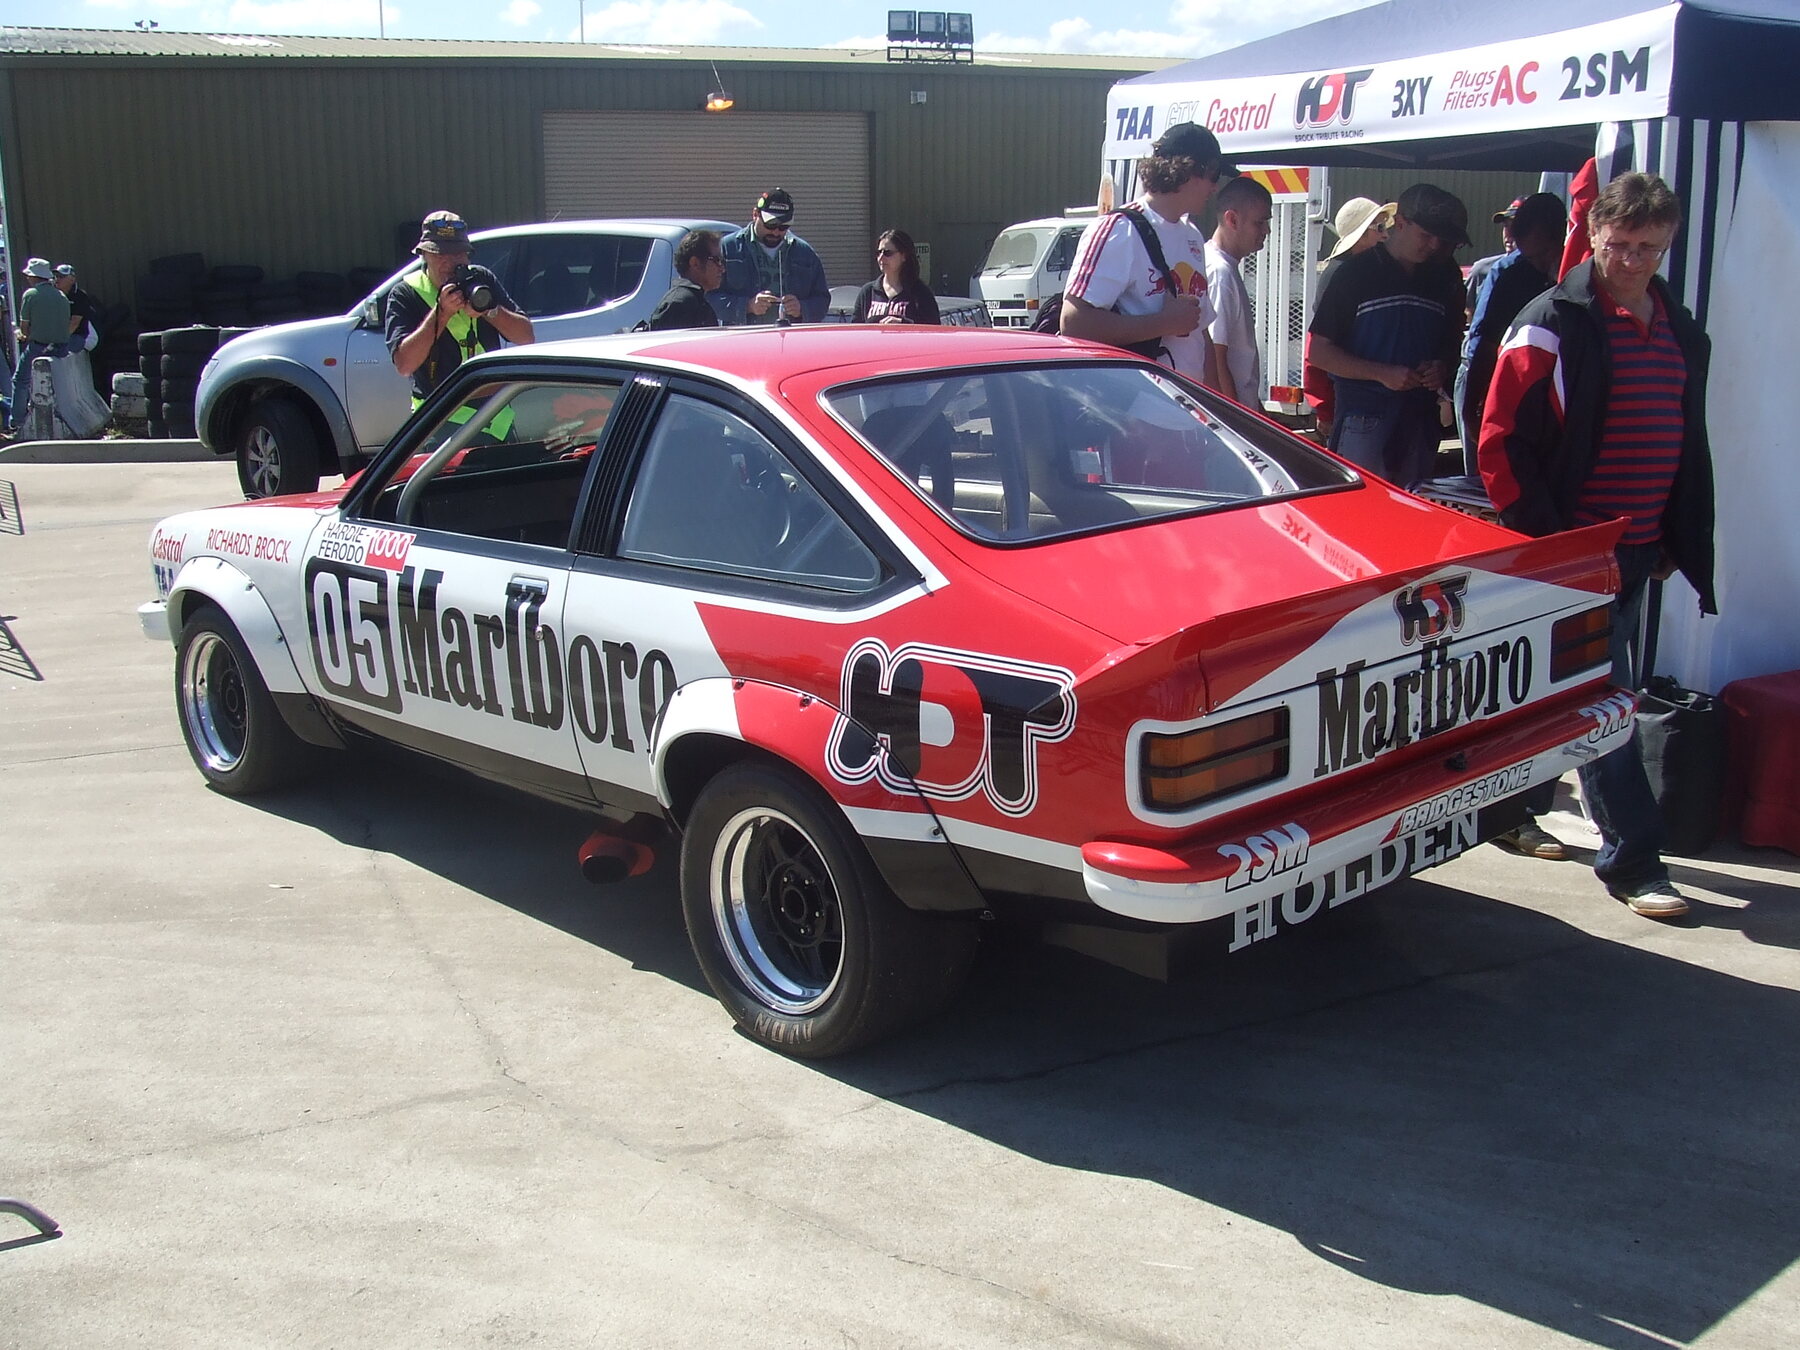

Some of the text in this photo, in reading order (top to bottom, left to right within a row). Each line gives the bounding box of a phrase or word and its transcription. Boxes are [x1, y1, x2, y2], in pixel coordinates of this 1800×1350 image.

[1450, 70, 1496, 92] Plugs
[1490, 61, 1539, 107] AC
[1559, 46, 1650, 100] 2SM
[1206, 93, 1276, 133] Castrol
[1293, 68, 1374, 130] HDT
[1391, 76, 1433, 118] 3XY
[1443, 91, 1489, 111] Filters
[1116, 105, 1154, 141] TAA
[1294, 129, 1364, 143] BROCK TRIBUTE RACING
[153, 528, 187, 563] Castrol
[206, 529, 291, 563] RICHARDS BROCK
[318, 540, 364, 563] FERODO
[369, 530, 412, 560] 1000
[314, 572, 389, 698] 05
[396, 565, 678, 754] Marlboro
[825, 637, 1078, 818] HDT
[1313, 636, 1533, 779] Marlboro
[1397, 760, 1534, 837] BRIDGESTONE
[1217, 822, 1310, 892] 2SM
[1229, 809, 1479, 954] HOLDEN
[754, 1012, 815, 1045] AVON
